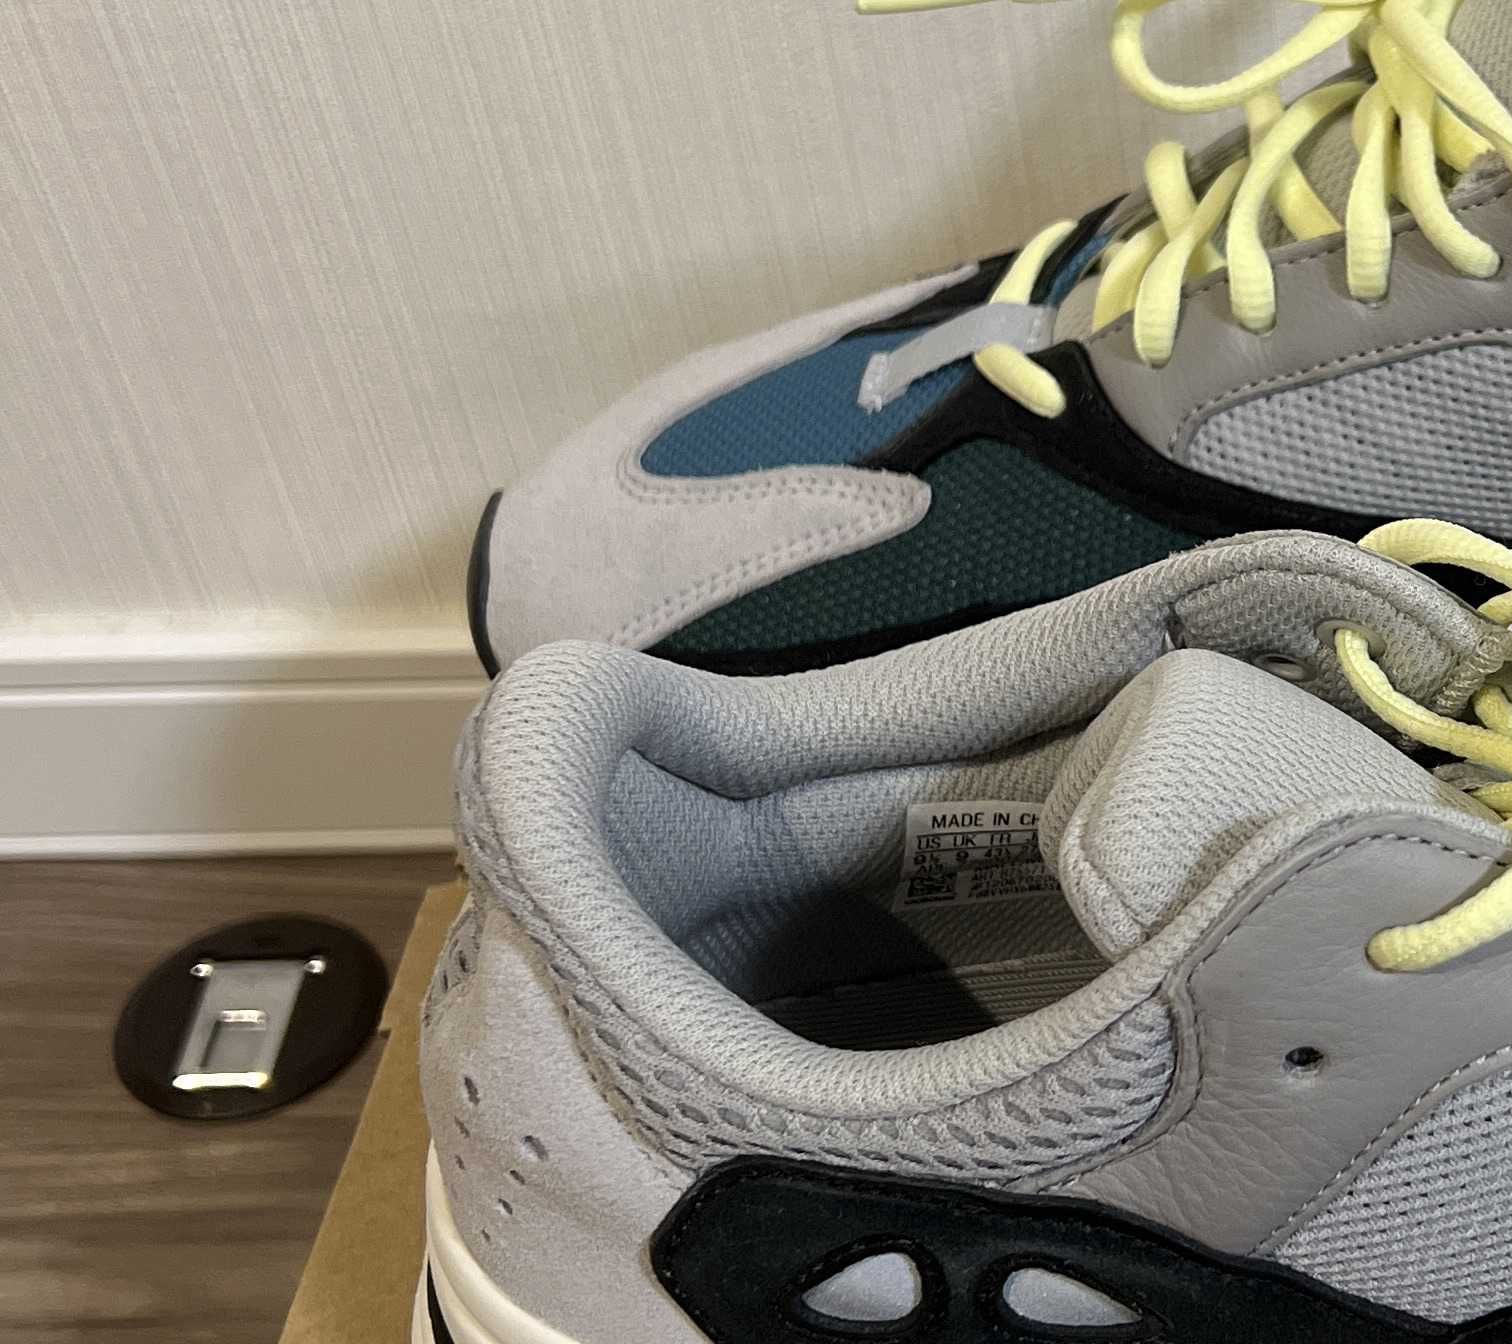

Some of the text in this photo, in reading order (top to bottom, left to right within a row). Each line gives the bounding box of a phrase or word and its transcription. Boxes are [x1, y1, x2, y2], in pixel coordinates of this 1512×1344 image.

[931, 811, 985, 829] MADE
[993, 811, 1011, 826] IN
[917, 836, 941, 850] US
[953, 833, 977, 847] UK
